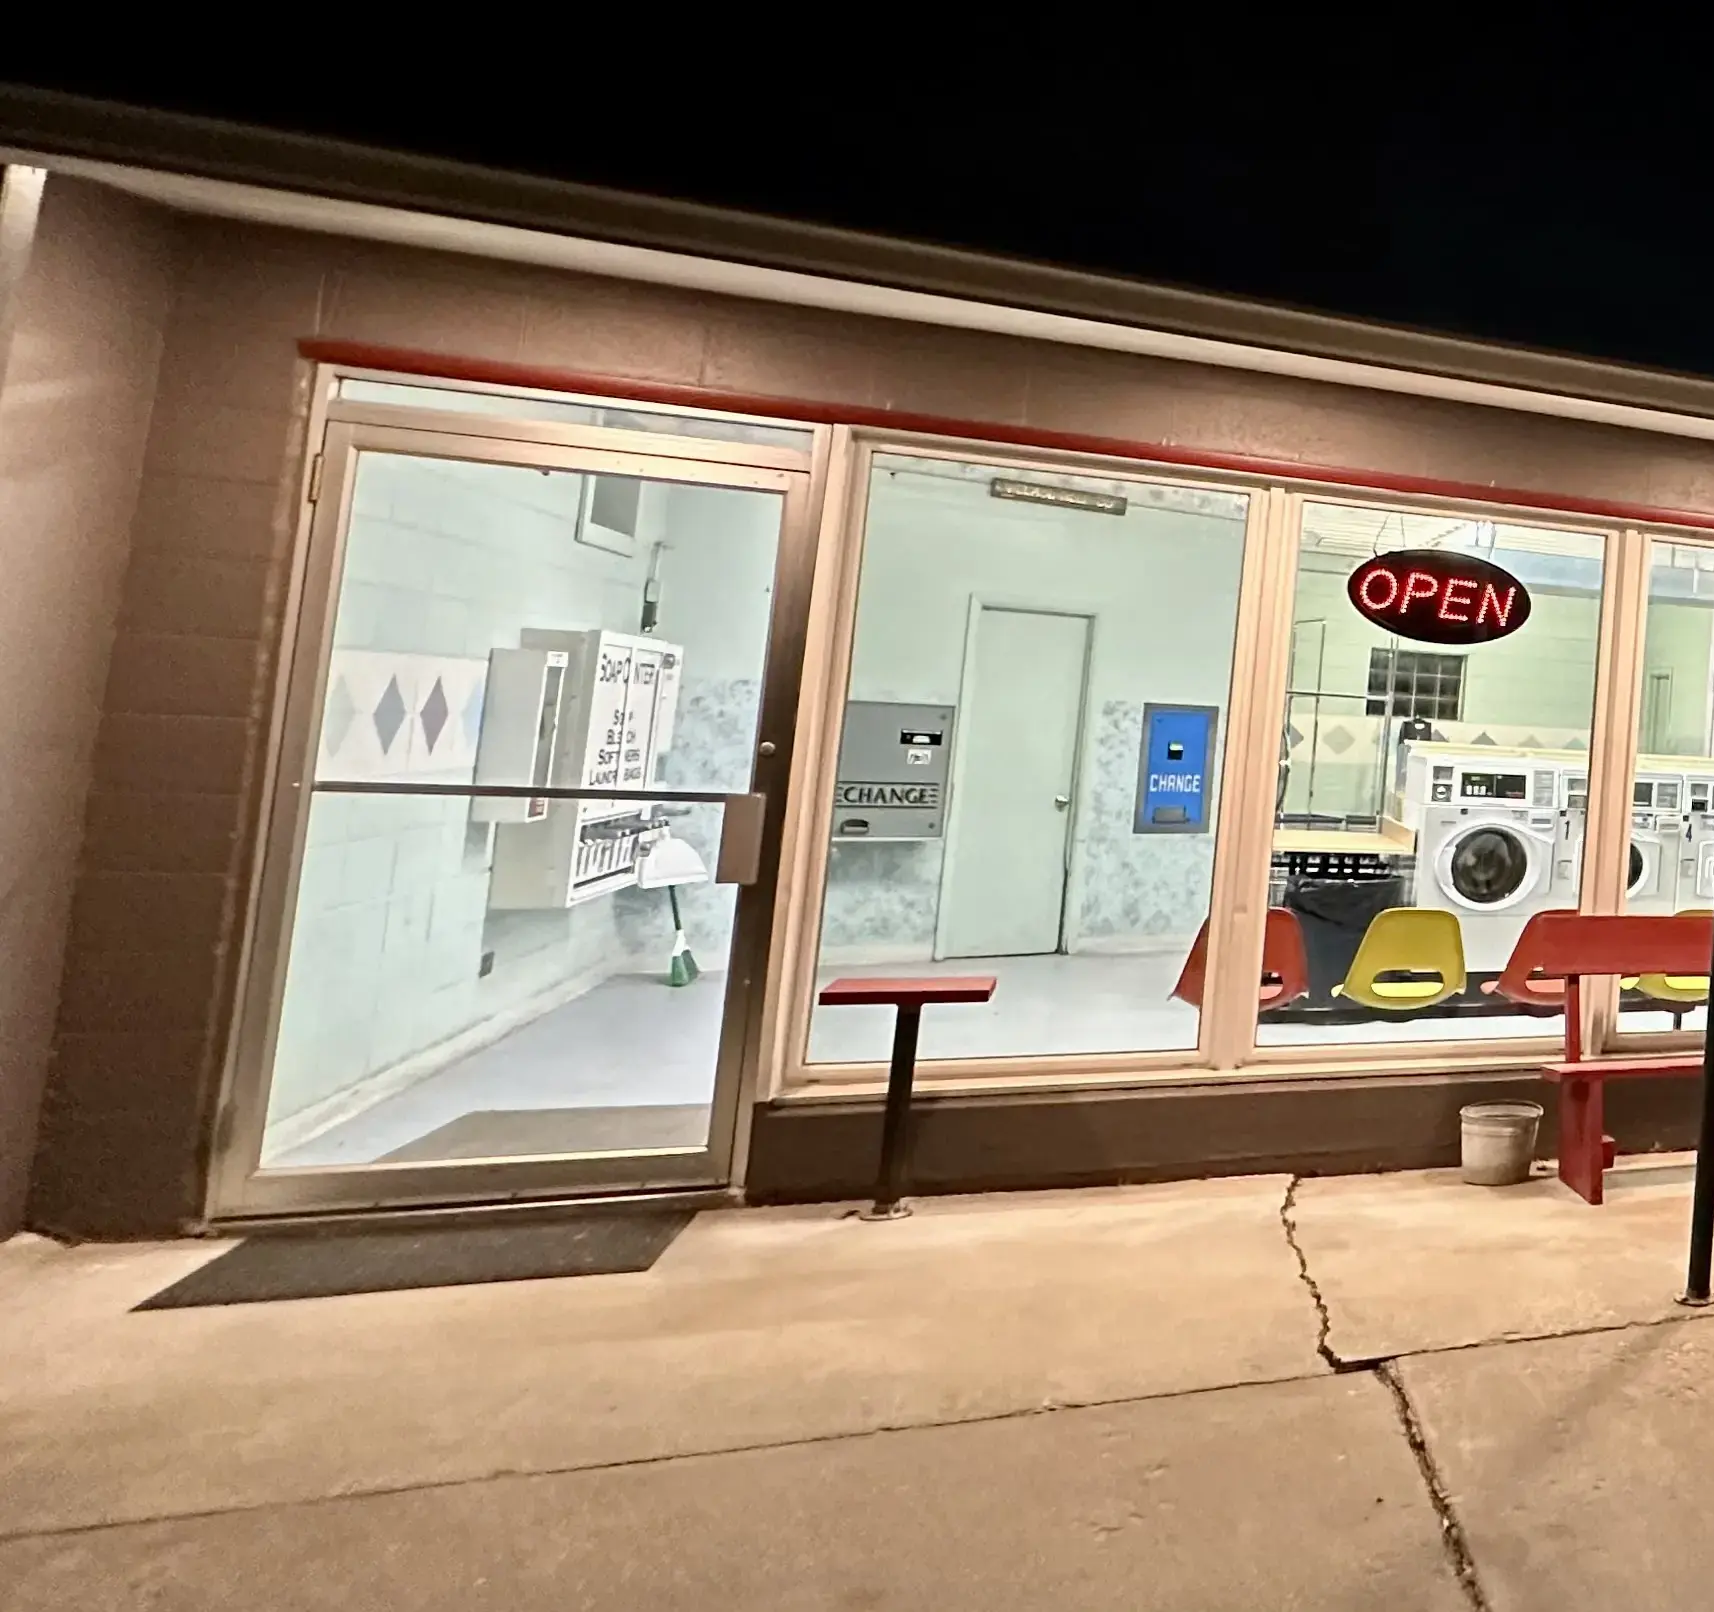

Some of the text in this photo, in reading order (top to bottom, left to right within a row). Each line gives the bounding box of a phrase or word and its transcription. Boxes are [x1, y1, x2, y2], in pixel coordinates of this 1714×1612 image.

[1360, 568, 1516, 627] OPEN
[600, 652, 656, 685] SOAP CNTER
[1149, 773, 1201, 793] CHANGE
[843, 786, 929, 804] CHANGE
[1564, 820, 1571, 840] 1
[1685, 824, 1692, 842] 4
